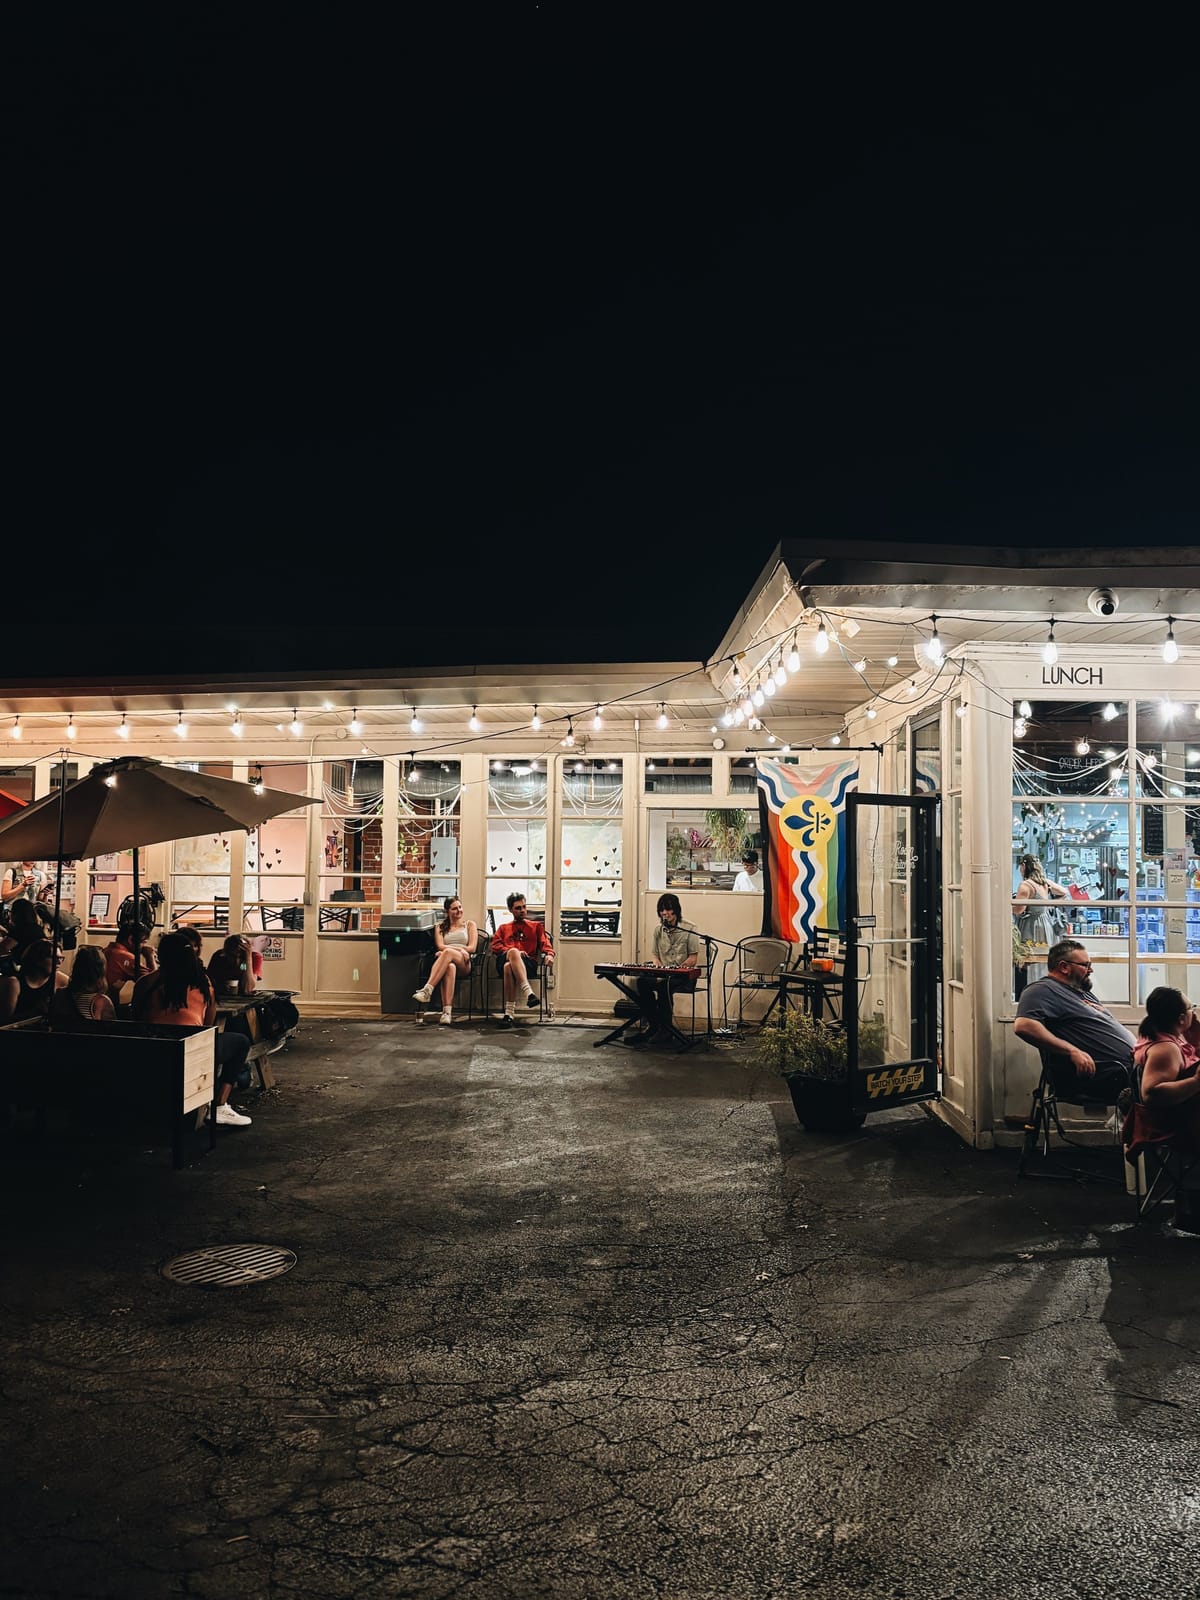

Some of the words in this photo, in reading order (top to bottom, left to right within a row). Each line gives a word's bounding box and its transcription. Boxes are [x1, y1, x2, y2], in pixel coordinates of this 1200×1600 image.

[1042, 666, 1103, 685] LUNCH
[871, 1079, 890, 1089] WATCH
[892, 1077, 907, 1086] YOUR
[907, 1073, 921, 1083] STEP
